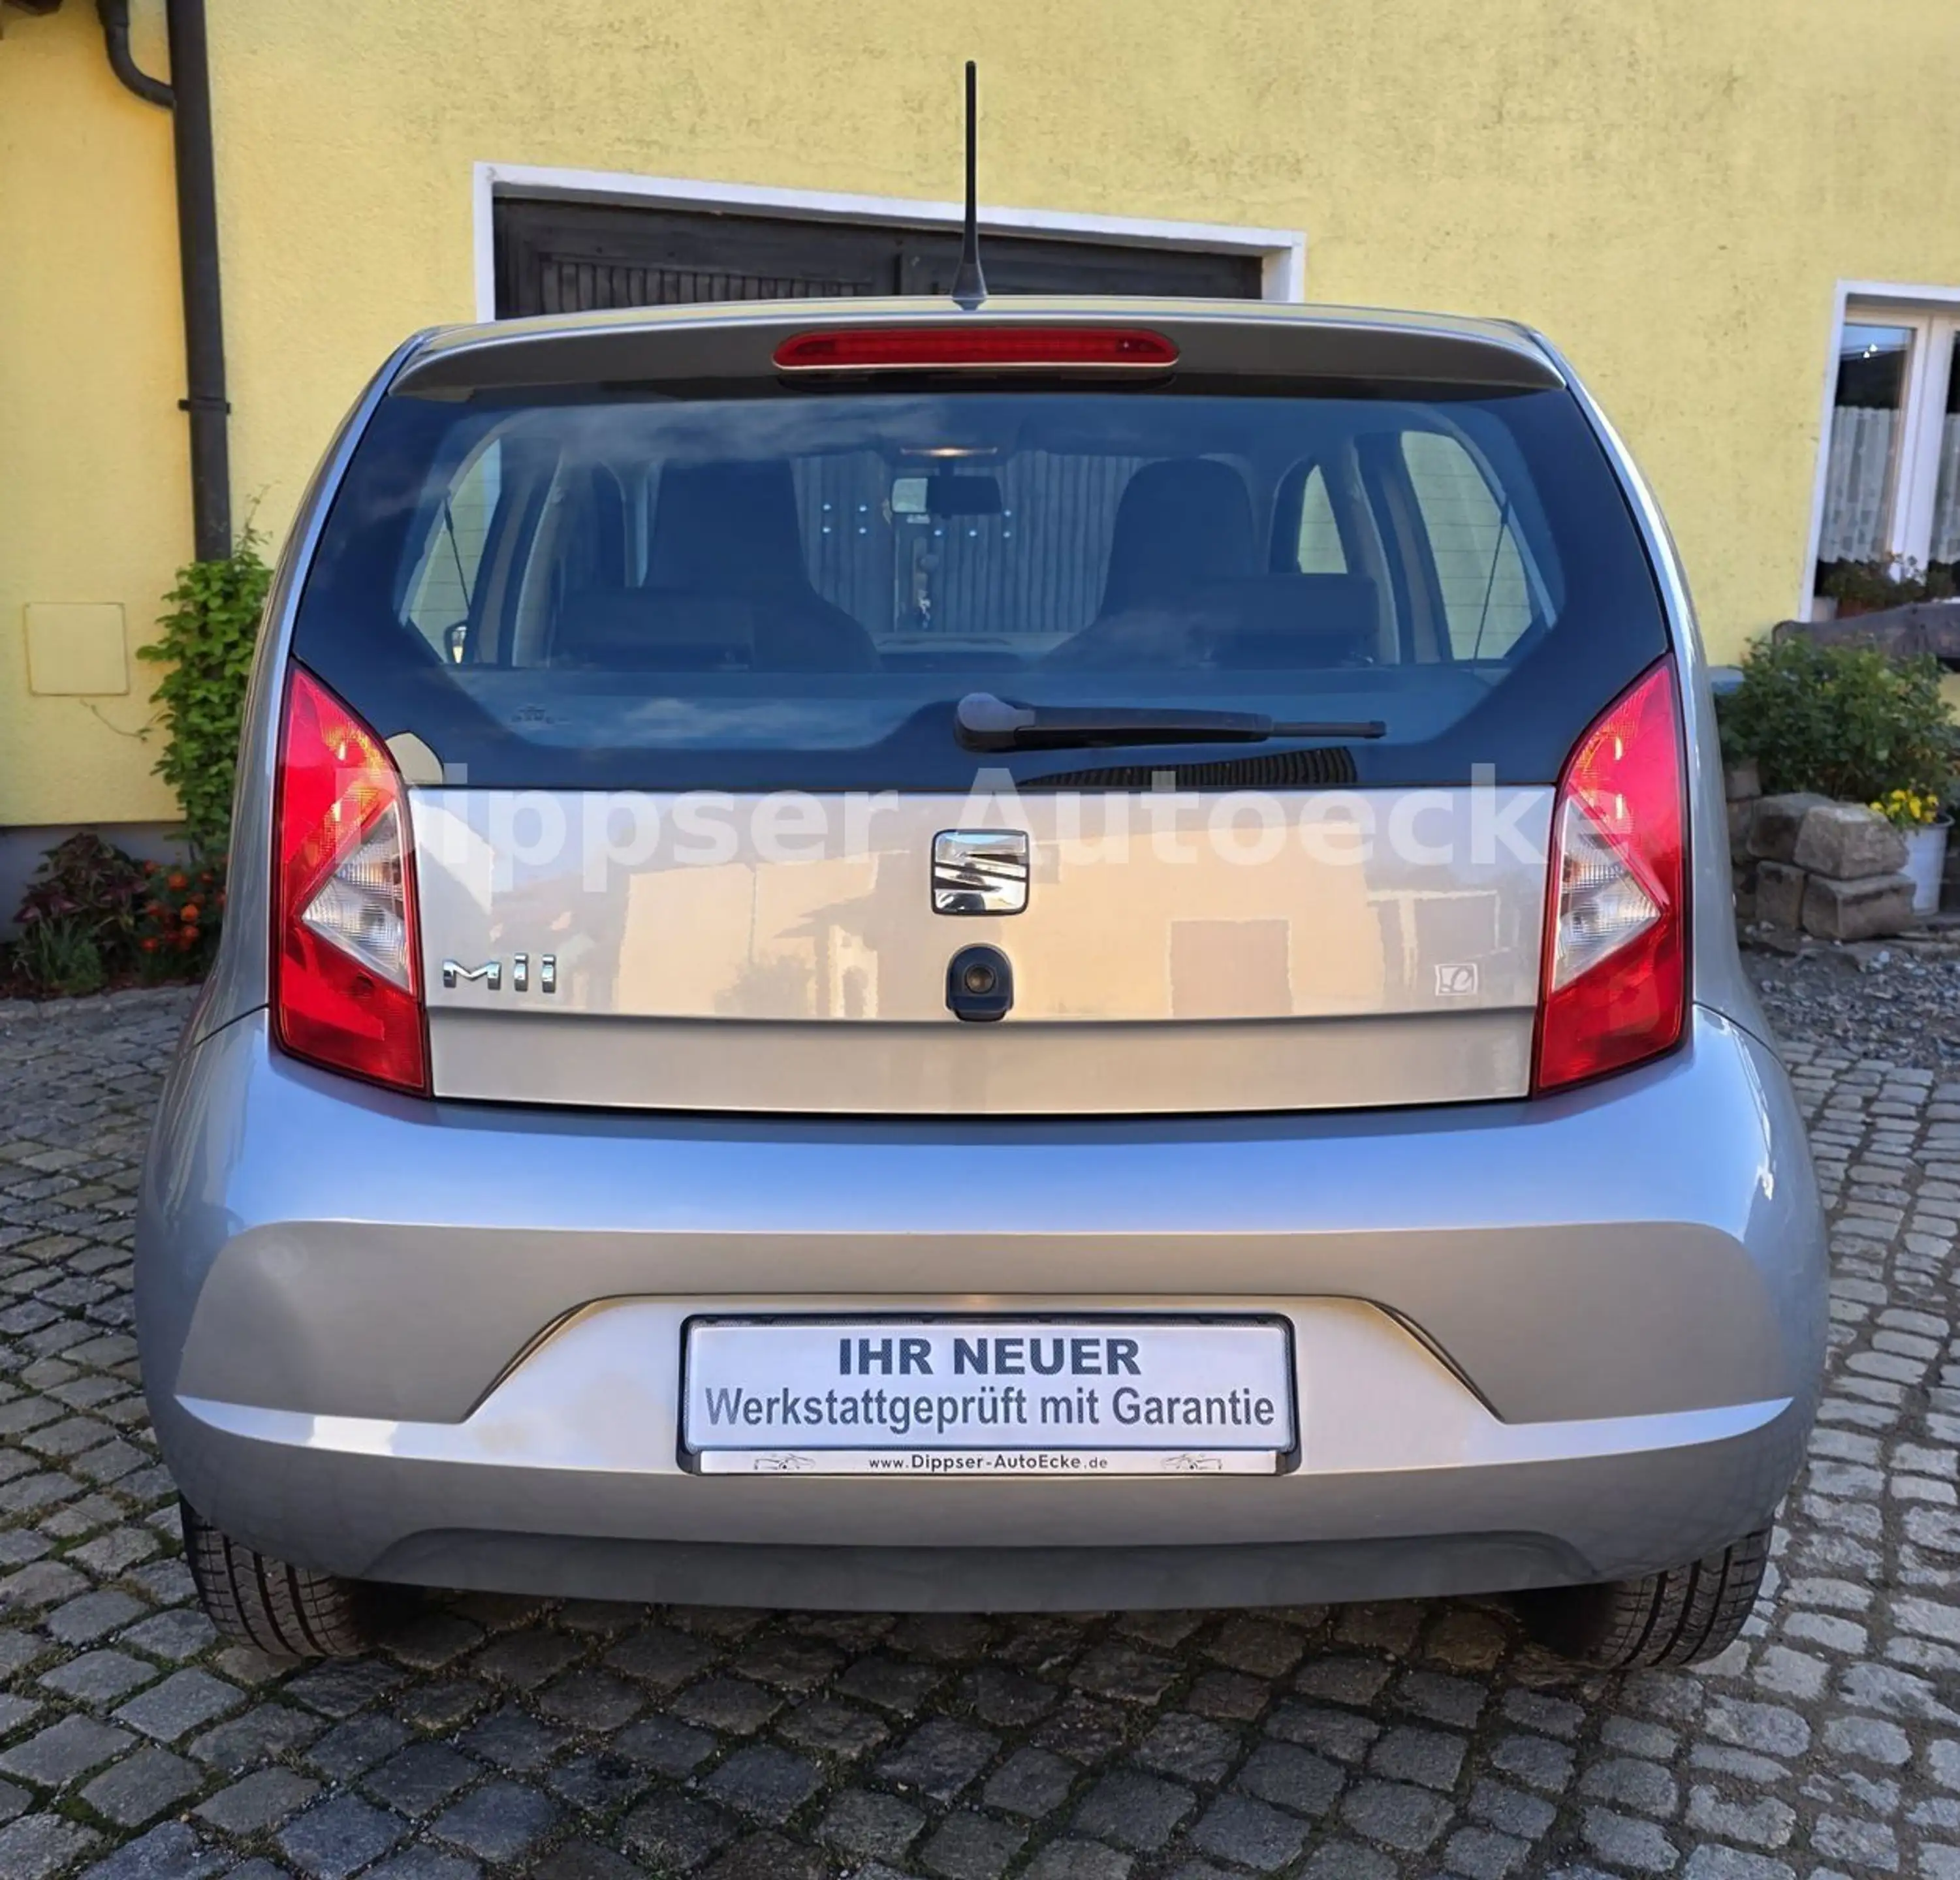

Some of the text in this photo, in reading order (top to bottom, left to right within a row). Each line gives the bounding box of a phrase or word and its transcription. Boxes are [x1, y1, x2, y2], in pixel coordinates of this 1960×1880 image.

[839, 1338, 1142, 1375] IHR NEUER
[705, 1386, 1275, 1435] Werkstattgeprüft mit Garantie
[868, 1453, 1108, 1473] www.Dippser-AutoEcke.de
